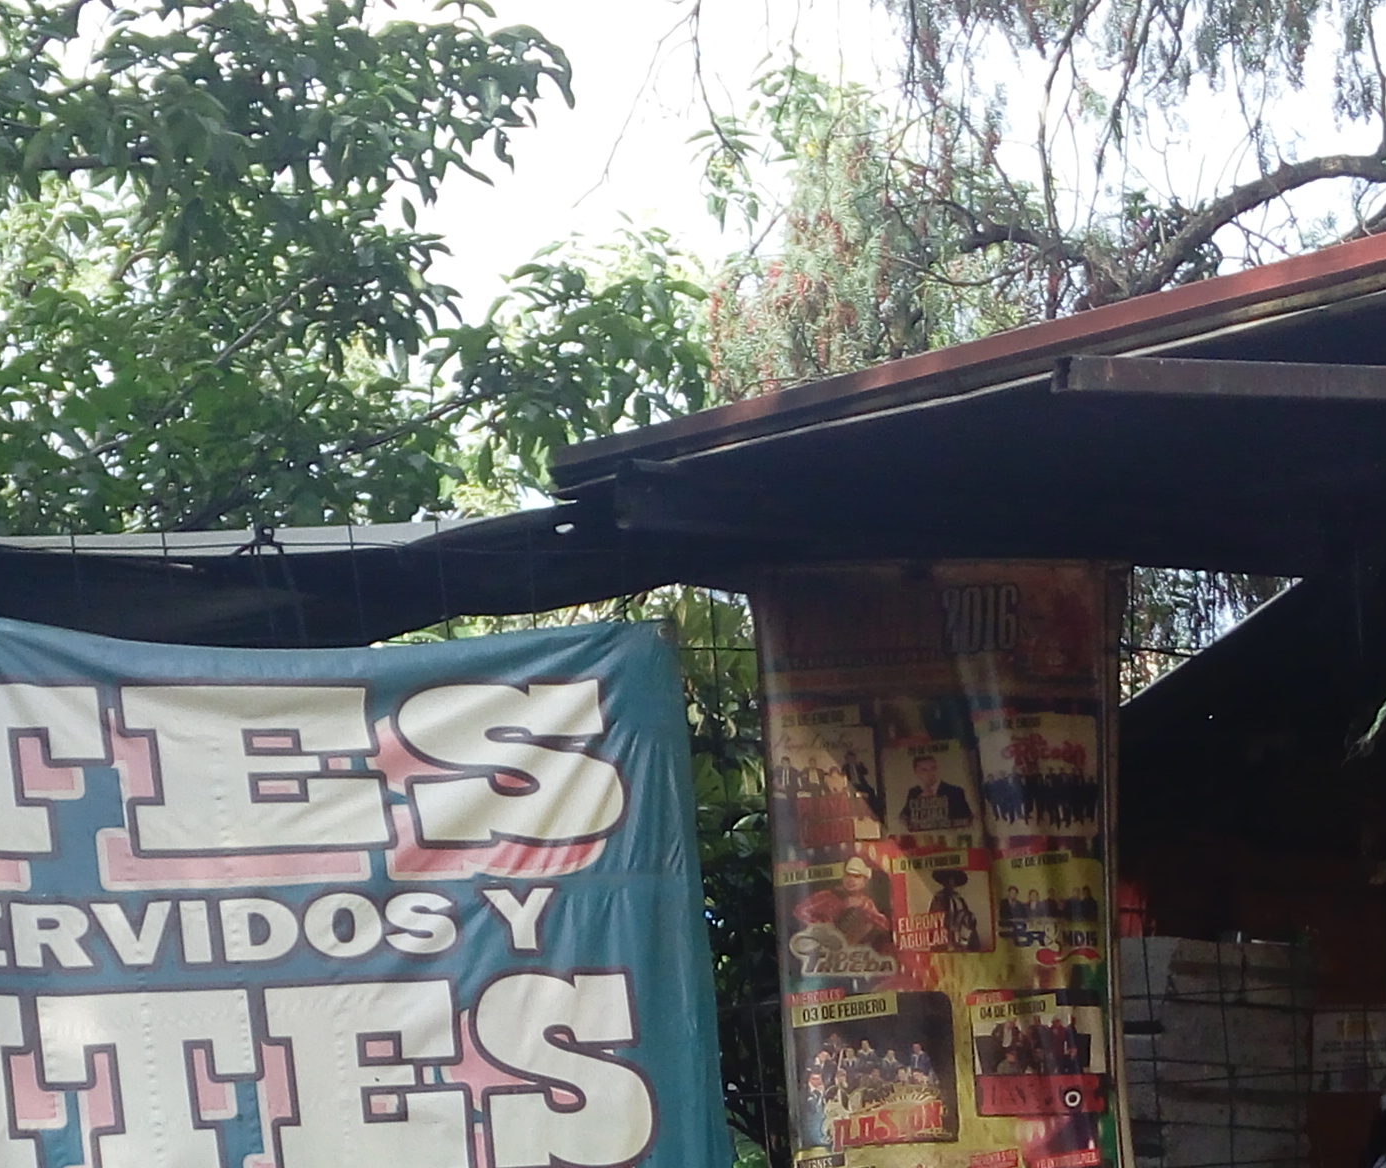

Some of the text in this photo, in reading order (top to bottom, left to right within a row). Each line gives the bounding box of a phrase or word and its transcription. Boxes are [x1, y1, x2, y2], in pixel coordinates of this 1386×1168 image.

[486, 885, 556, 954] Y
[898, 911, 946, 934] EL PONY
[899, 927, 949, 951] AGUILAR
[802, 998, 887, 1022] 03 DE FEBRERO
[979, 1006, 992, 1020] 04
[994, 1004, 1006, 1018] DE
